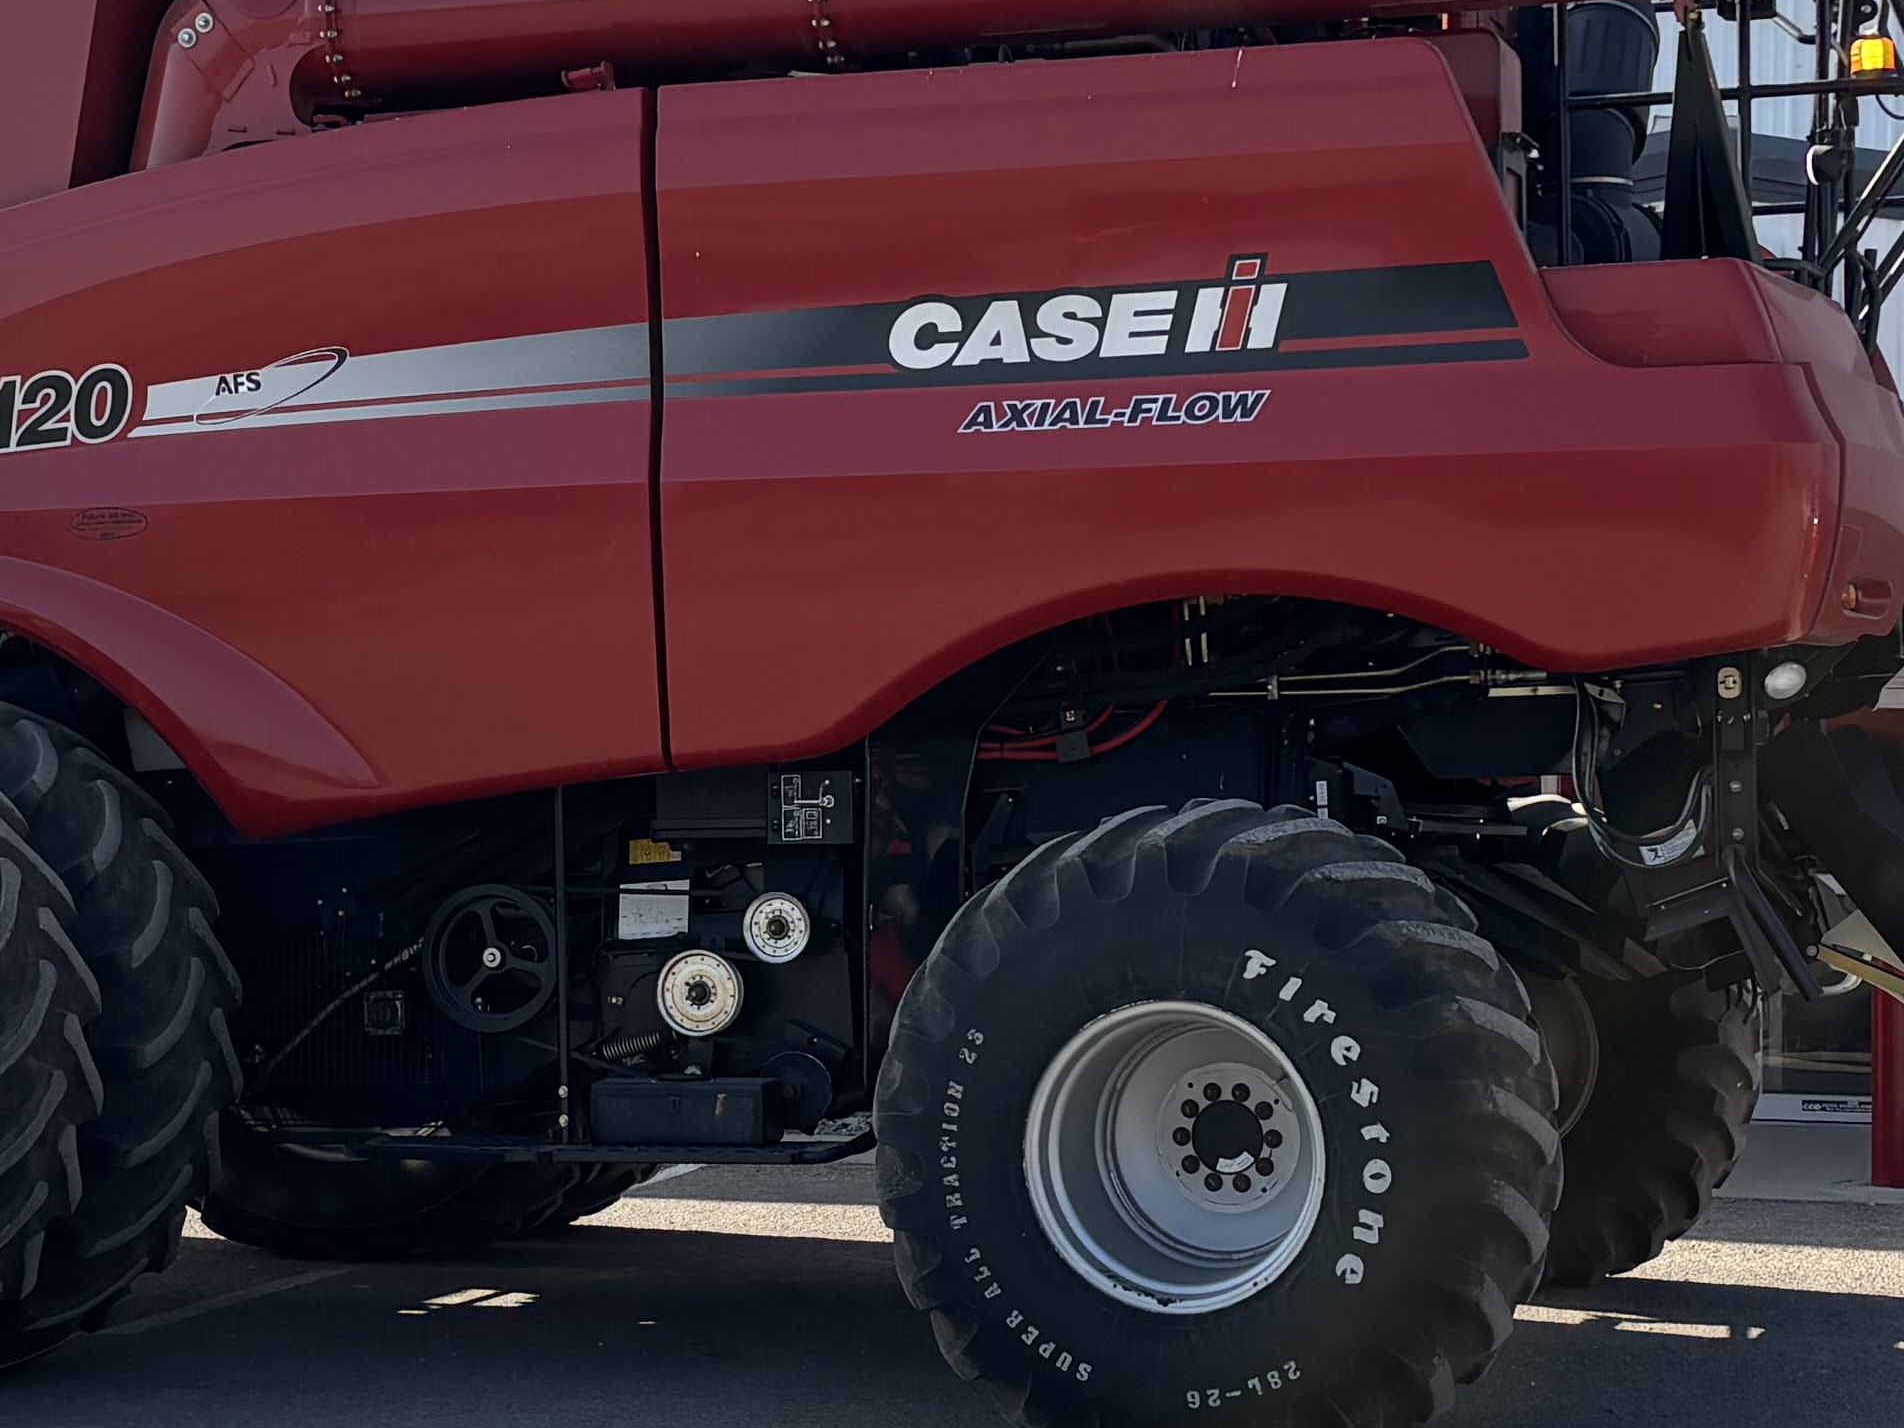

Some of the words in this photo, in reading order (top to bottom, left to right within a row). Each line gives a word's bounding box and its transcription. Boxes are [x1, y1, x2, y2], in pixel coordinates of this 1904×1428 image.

[888, 289, 1178, 369] CASE
[215, 372, 262, 397] AFS
[957, 389, 1271, 433] AXIAL-FLOW
[1242, 949, 1393, 1285] Firestone
[939, 1080, 969, 1230] TRACTION
[964, 1247, 1002, 1299] ALL
[1005, 1309, 1093, 1382] SUPER
[1186, 1360, 1301, 1409] 28L-26
